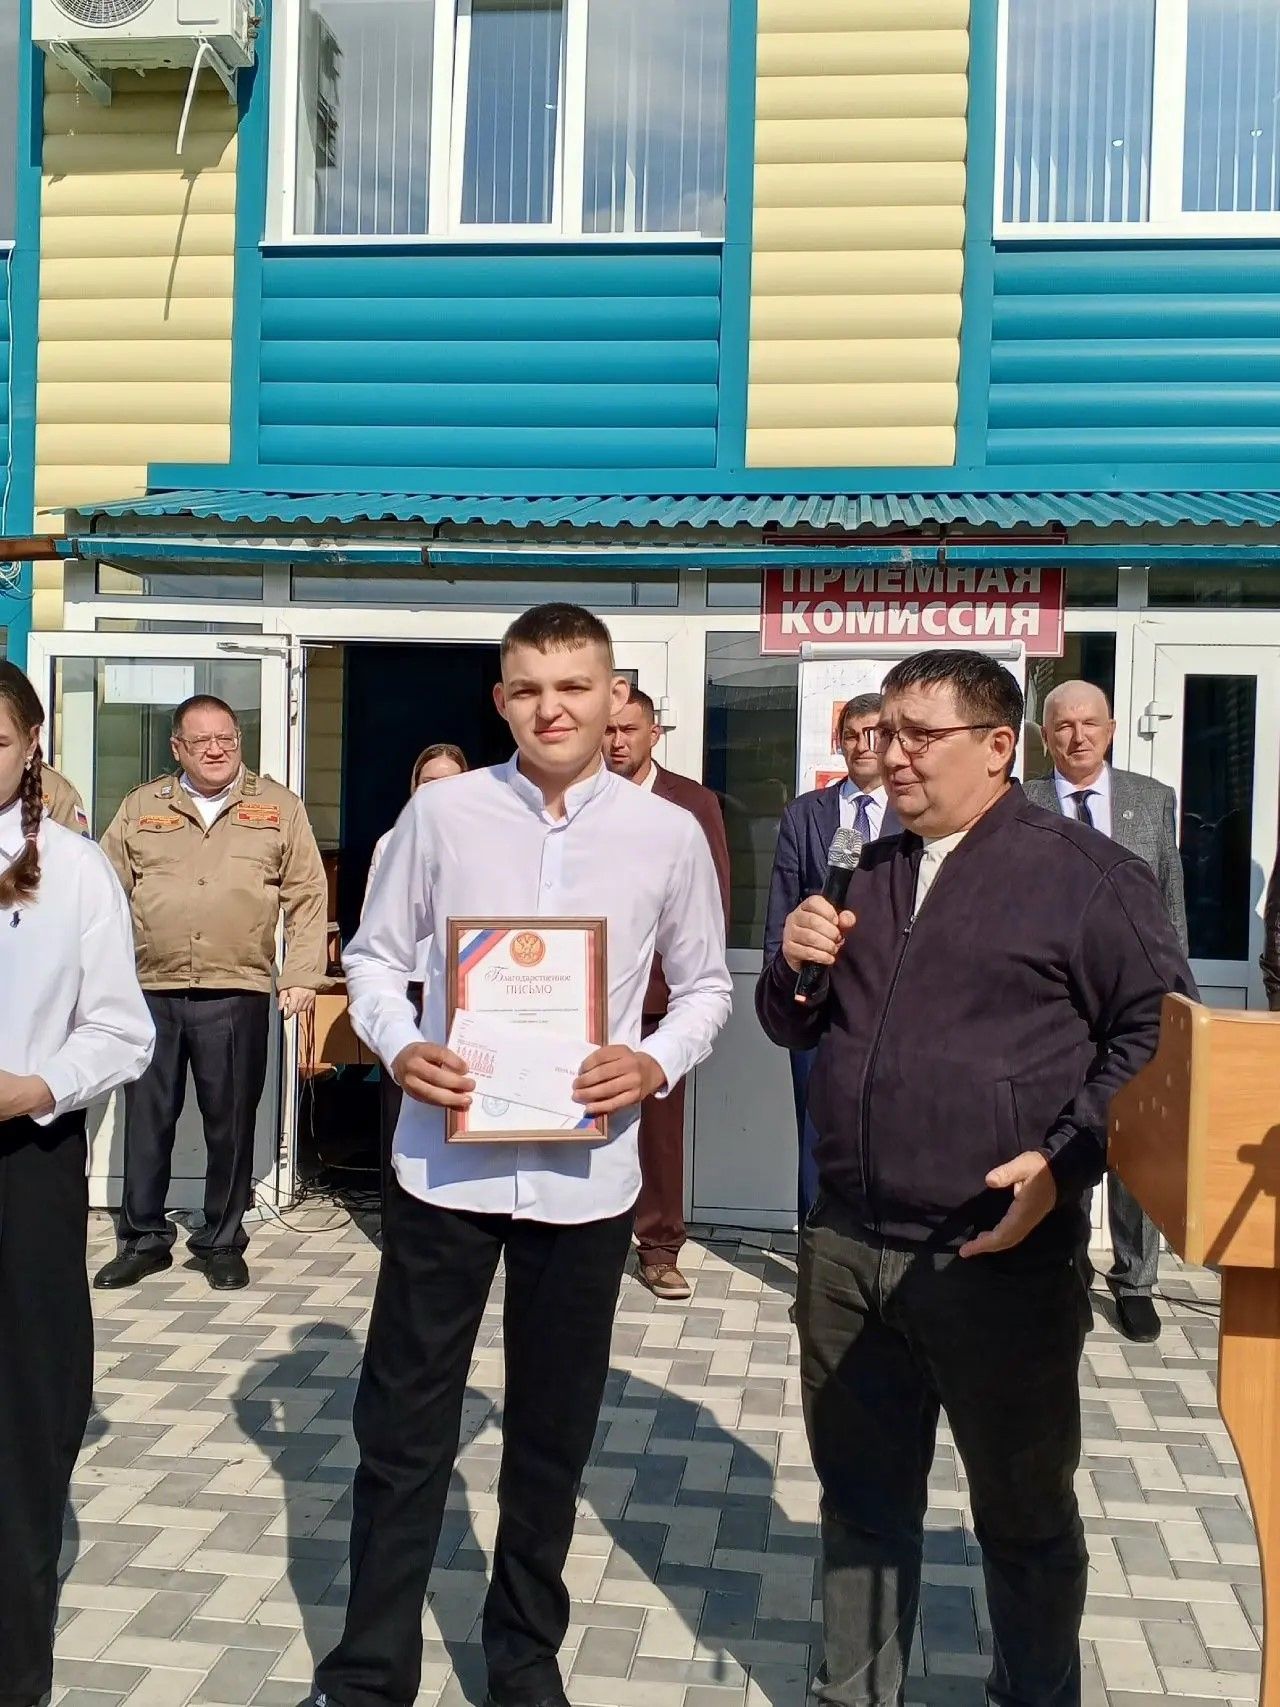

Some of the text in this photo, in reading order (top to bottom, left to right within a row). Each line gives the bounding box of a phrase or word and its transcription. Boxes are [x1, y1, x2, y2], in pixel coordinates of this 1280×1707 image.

[781, 601, 1040, 636] КОМИССИЯ
[484, 966, 571, 984] Благодарственное
[505, 985, 553, 994] ПИСЬМО
